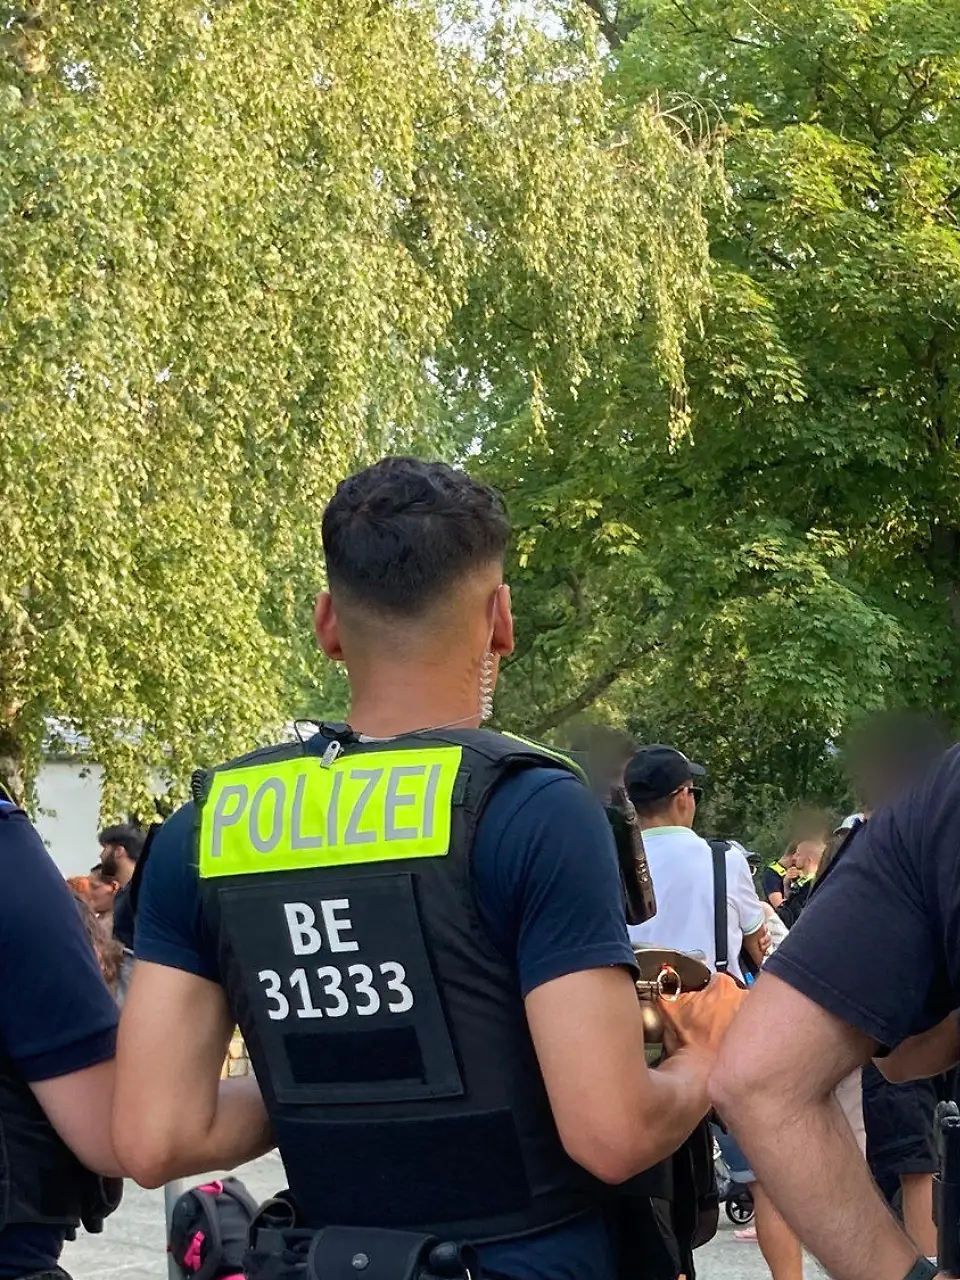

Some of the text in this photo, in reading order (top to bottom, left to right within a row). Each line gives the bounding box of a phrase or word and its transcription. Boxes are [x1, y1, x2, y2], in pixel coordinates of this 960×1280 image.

[210, 763, 442, 858] POLIZEI
[284, 898, 360, 956] BE
[257, 961, 415, 1021] 31333
